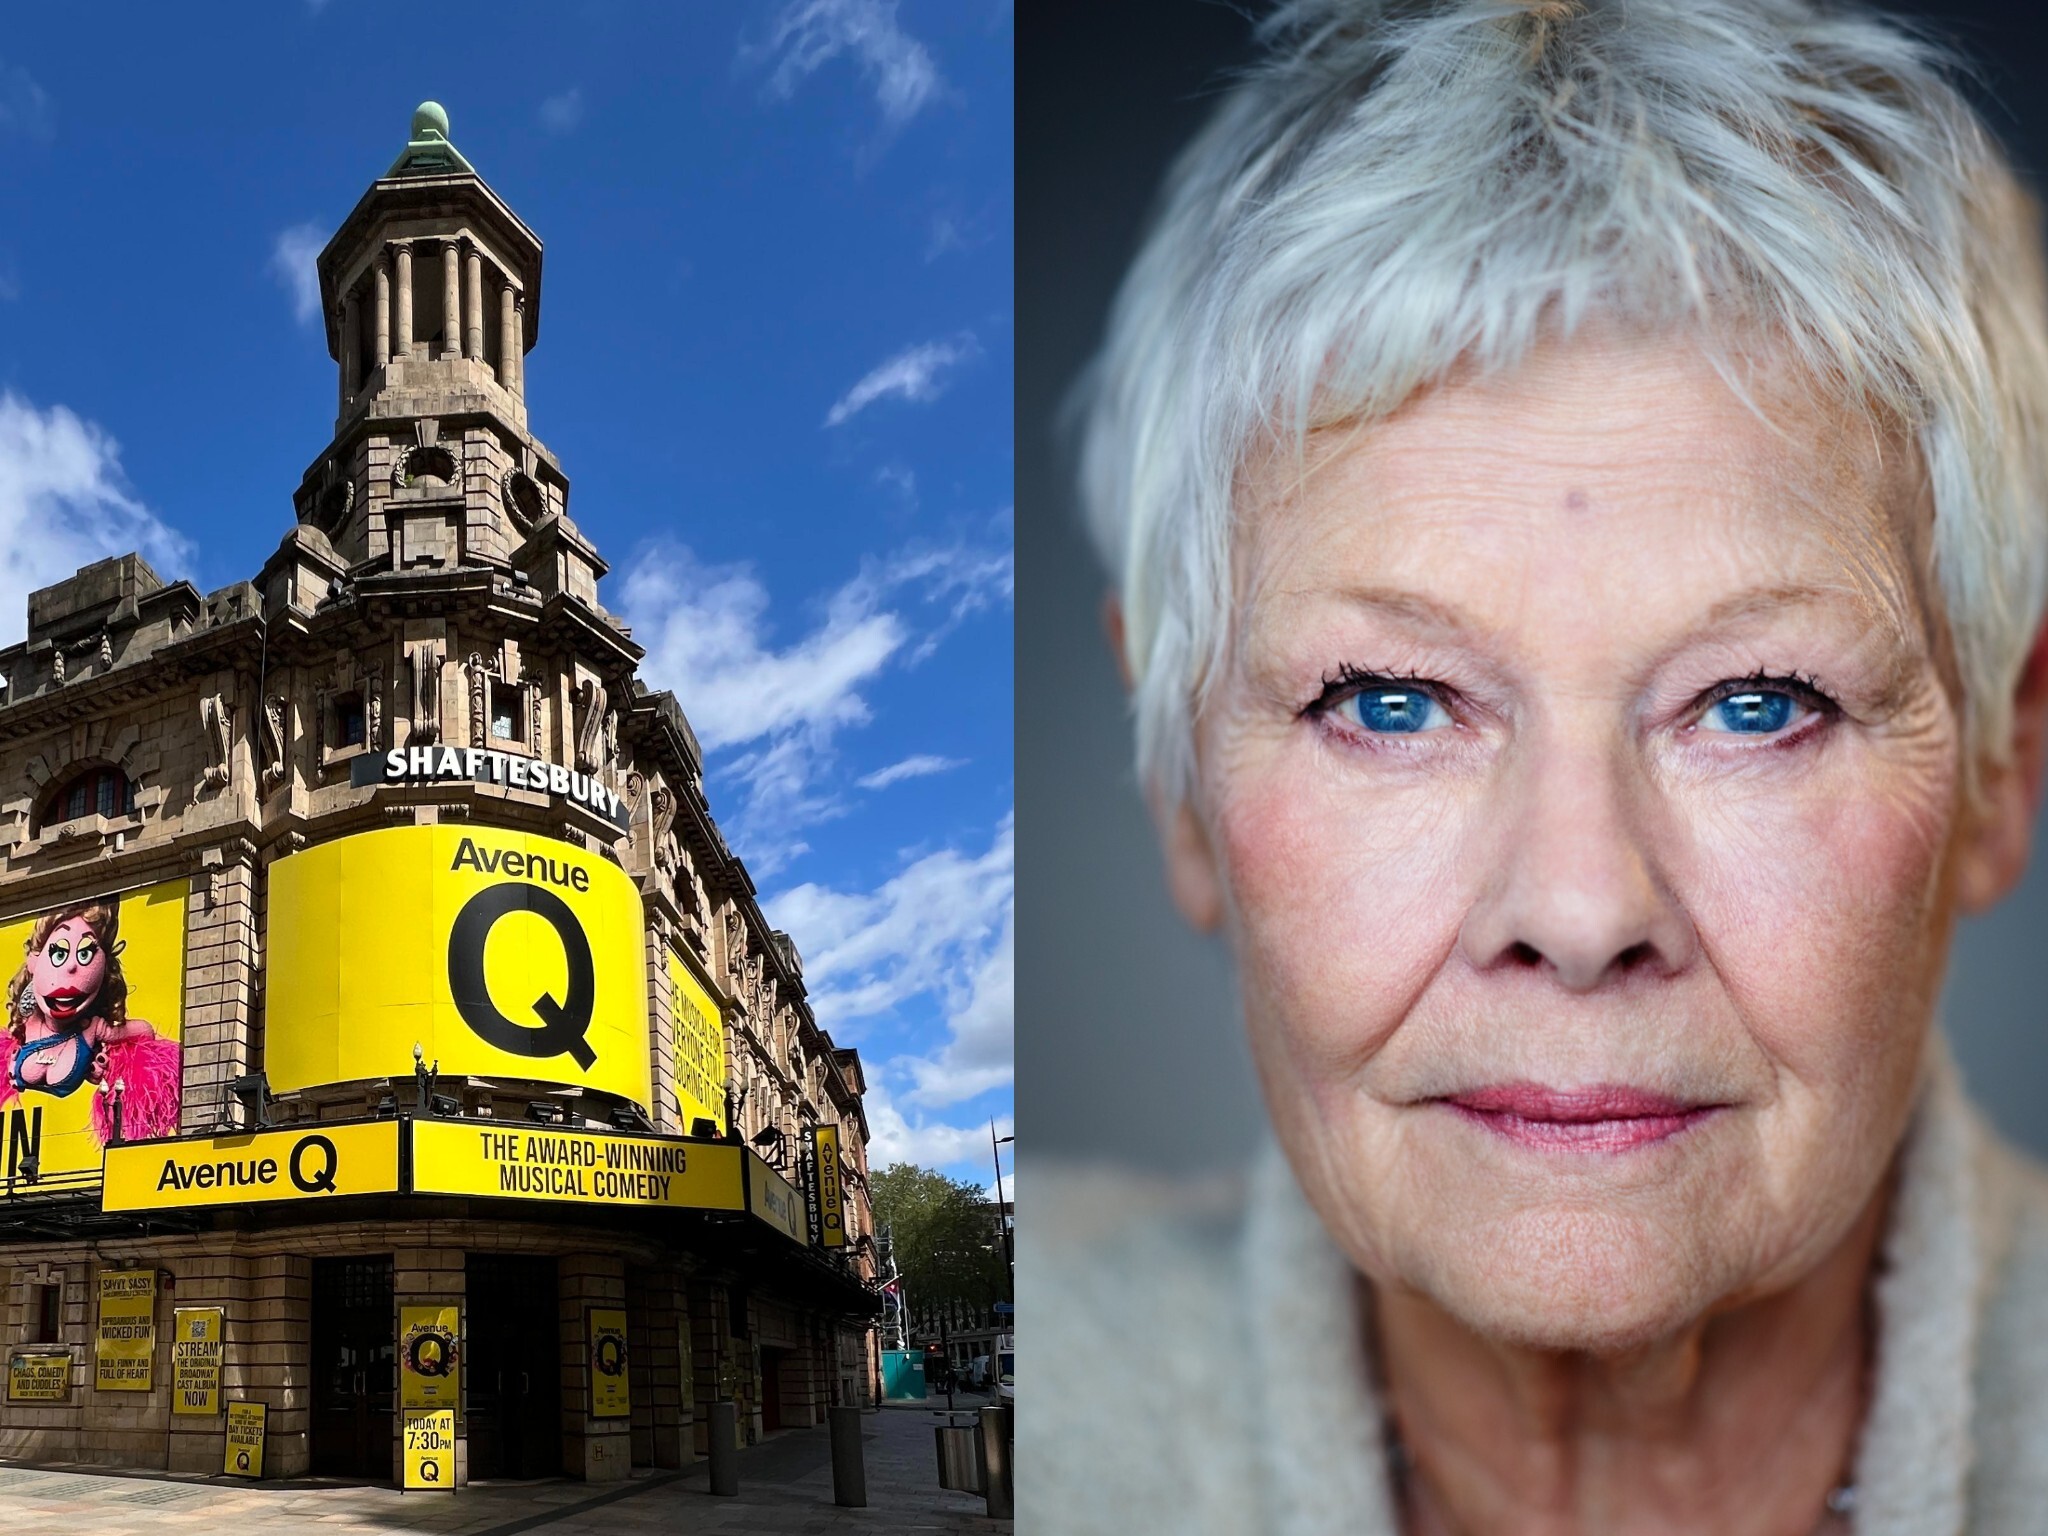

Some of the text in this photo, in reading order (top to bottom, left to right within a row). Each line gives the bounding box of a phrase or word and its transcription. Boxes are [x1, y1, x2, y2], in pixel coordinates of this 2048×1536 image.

[386, 746, 620, 819] SHAFTESBURY
[450, 837, 589, 893] Avenue
[447, 881, 598, 1073] Q
[671, 980, 721, 1058] HE MUSICAL FOR
[672, 1014, 723, 1090] VERYONE STILL
[673, 1051, 703, 1104] IGURING
[480, 1132, 686, 1174] THE AWARD-WINNING
[156, 1134, 337, 1194] Avenue Q
[500, 1164, 671, 1200] MUSICAL COMEDY
[803, 1131, 819, 1244] SHAFTESBURY
[822, 1143, 841, 1230] Avenue Q
[128, 1277, 151, 1289] SASSY
[101, 1326, 132, 1339] WICKED
[411, 1323, 449, 1333] Avenue
[178, 1342, 218, 1356] STREAM
[410, 1332, 450, 1378] Q
[597, 1335, 624, 1377] Q
[38, 1367, 65, 1378] COMEDY
[177, 1358, 219, 1367] THE ORIGINAL
[100, 1369, 115, 1379] FULL
[116, 1369, 126, 1379] OF
[180, 1369, 214, 1378] BROADWAY
[177, 1380, 217, 1389] CAST ALBUM
[184, 1391, 208, 1406] NOW
[229, 1424, 263, 1436] DAY TICKETS
[407, 1417, 451, 1430] TODAY AT
[231, 1434, 260, 1446] AVAILABLE
[237, 1452, 249, 1471] Q
[420, 1460, 439, 1482] Q
